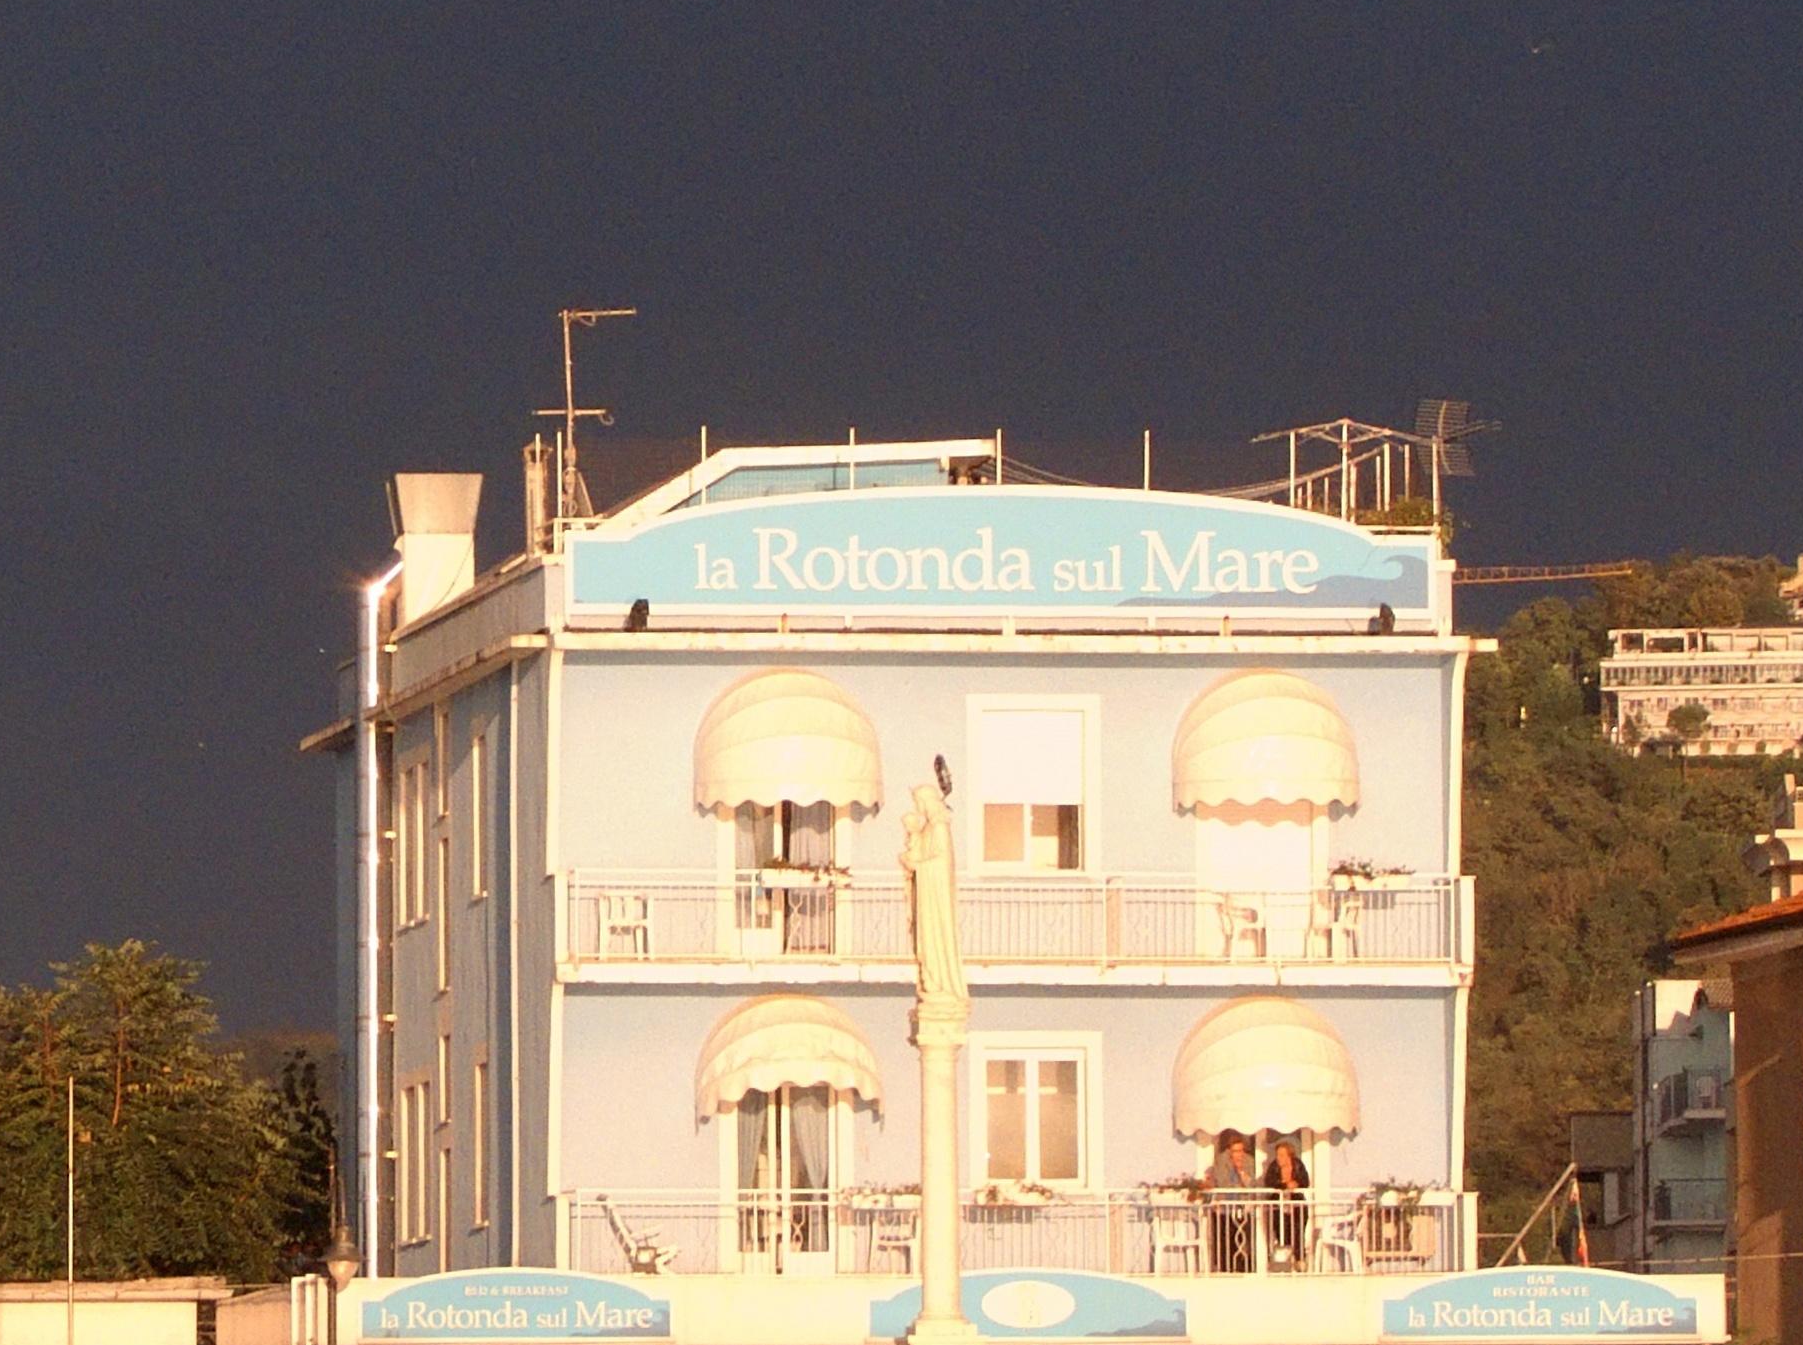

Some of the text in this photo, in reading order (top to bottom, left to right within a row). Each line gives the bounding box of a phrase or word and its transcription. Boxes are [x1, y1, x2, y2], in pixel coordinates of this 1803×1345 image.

[694, 527, 1320, 594] la Rotonda sul Mare
[1527, 1274, 1555, 1285] BAR
[501, 1285, 569, 1296] BREAKFAST
[1493, 1286, 1590, 1297] RISTORANTE
[380, 1301, 653, 1329] la Rotonda sul Mare
[1408, 1300, 1674, 1328] la Rotonda sul Mare
